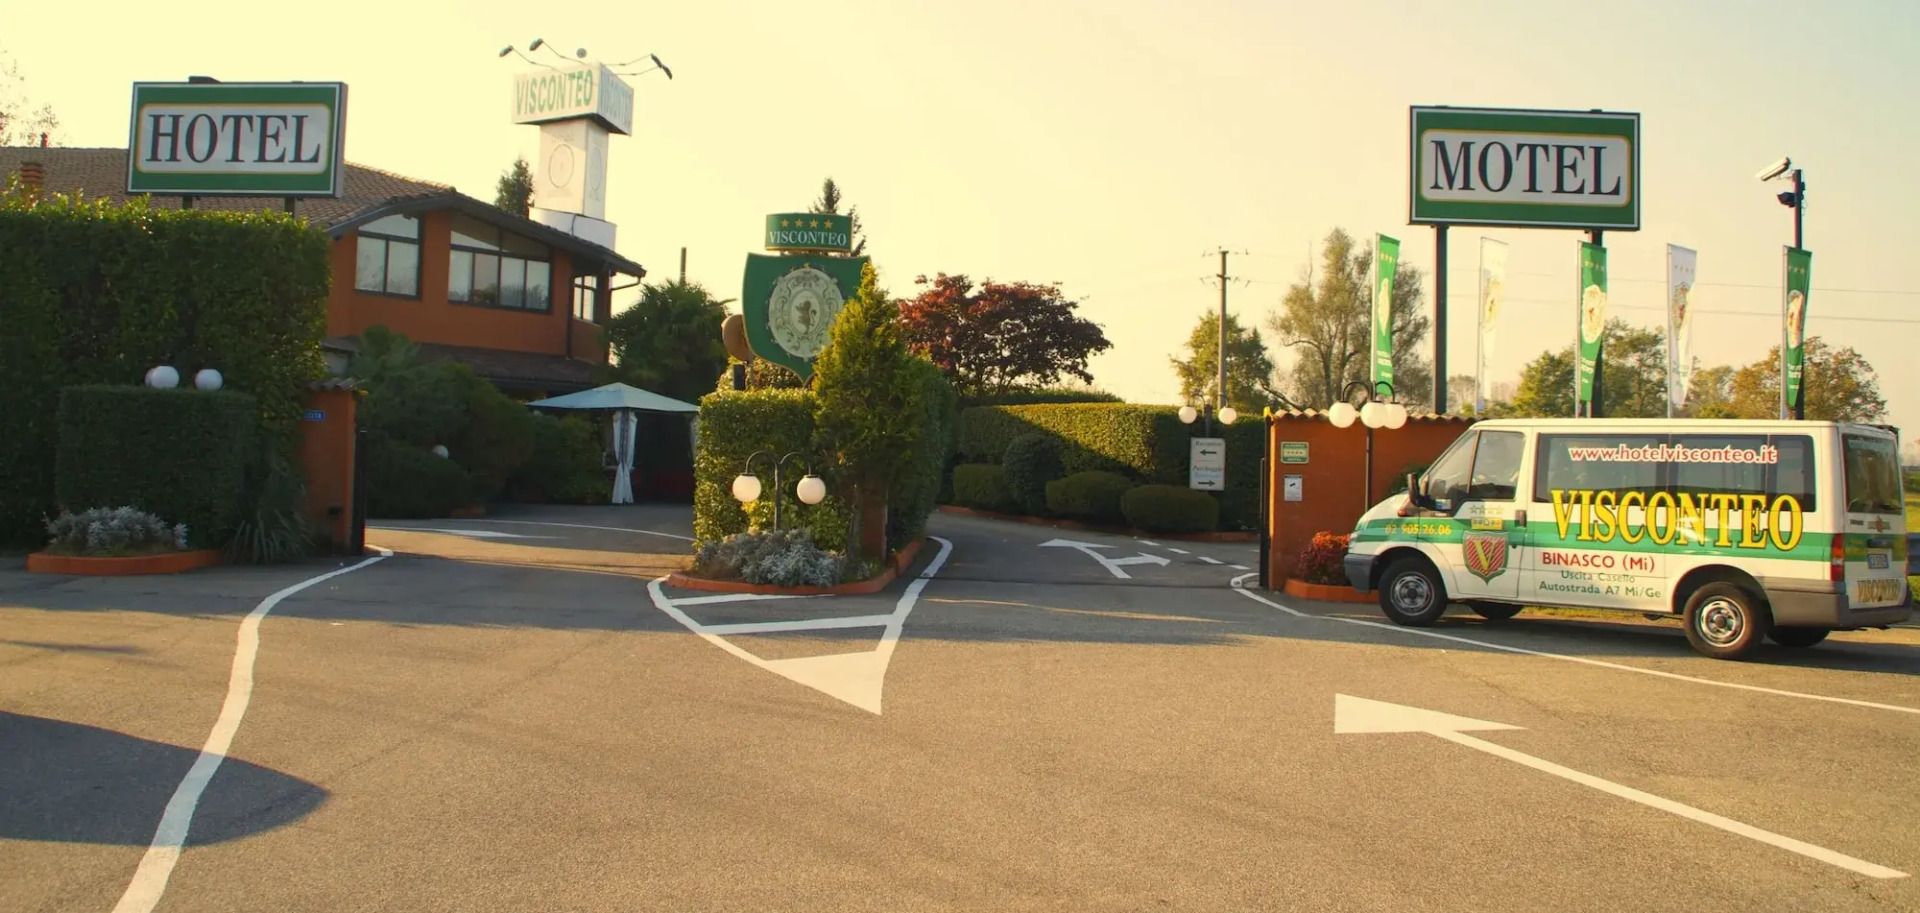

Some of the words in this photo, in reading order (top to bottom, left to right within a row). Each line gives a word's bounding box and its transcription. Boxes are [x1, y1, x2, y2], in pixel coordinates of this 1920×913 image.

[516, 69, 594, 116] VISCONTEO
[145, 113, 321, 164] HOTEL
[1430, 139, 1621, 196] MOTEL
[769, 230, 847, 247] VISCONTEO
[1568, 443, 1778, 464] www.hotelvisconteo.it
[1385, 523, 1398, 534] 02
[1550, 488, 1804, 551] VISCONTEO
[1541, 551, 1615, 568] BINASCO
[1622, 553, 1656, 573] (Mi)
[1560, 569, 1594, 581] Uscita
[1597, 572, 1636, 584] Casello
[1539, 580, 1600, 595] Autostrada
[1605, 584, 1621, 596] A7
[1625, 586, 1662, 599] Mi/Ge
